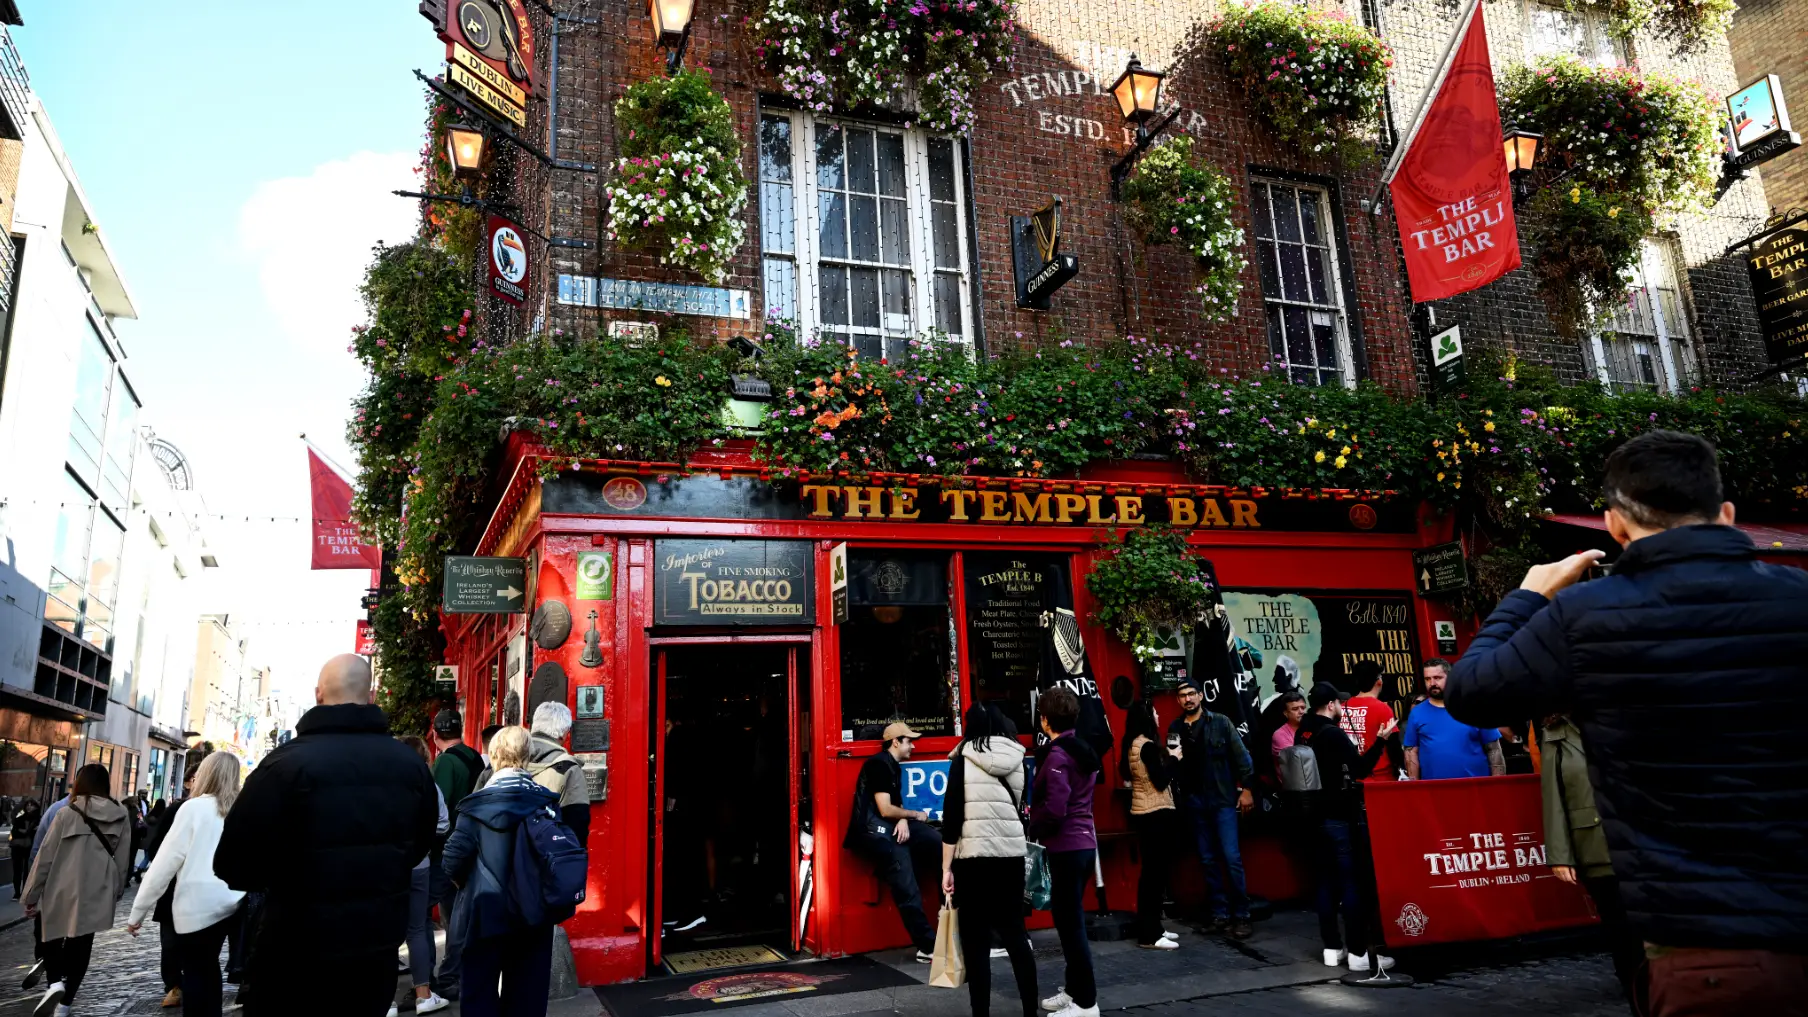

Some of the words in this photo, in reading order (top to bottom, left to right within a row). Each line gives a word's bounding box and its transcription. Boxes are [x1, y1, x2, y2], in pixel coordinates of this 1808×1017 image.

[517, 16, 530, 53] BAR
[469, 56, 512, 95] DUBLIN
[460, 71, 485, 96] LIVE
[487, 91, 520, 120] MUSIC
[1002, 71, 1111, 107] TEMPL
[1739, 137, 1788, 165] GUINNESS
[1436, 196, 1477, 221] THE
[1443, 232, 1495, 263] BAR
[1770, 234, 1795, 249] THE
[1751, 241, 1808, 271] TEMPL
[1028, 261, 1060, 294] GUINNESS
[1770, 257, 1808, 280] BAR
[495, 277, 524, 296] GUINNESS
[1762, 297, 1786, 312] BEER
[1787, 288, 1808, 302] GAR
[1771, 327, 1796, 342] LIVE
[1787, 332, 1808, 346] DAI
[608, 483, 637, 502] 48
[803, 485, 920, 520] THE
[942, 489, 1146, 525] TEMPLE
[1168, 497, 1261, 527] BAR
[318, 535, 364, 545] TEMPL
[334, 528, 356, 536] THE
[331, 546, 360, 554] BAR
[661, 547, 725, 577] Importers
[701, 561, 713, 569] OF
[718, 566, 742, 576] FINE
[744, 567, 790, 576] SMOKING
[977, 571, 1031, 587] TEMPLE
[682, 572, 791, 611] TOBACCO
[703, 604, 745, 614] Always
[752, 604, 761, 613] in
[768, 604, 801, 613] Stock
[981, 610, 998, 618] Meat
[1259, 601, 1293, 618] THE
[1382, 604, 1406, 624] 1840
[973, 620, 992, 628] Fresh
[1244, 618, 1310, 634] TEMPLE
[1263, 634, 1298, 651] BAR
[1376, 629, 1410, 651] THE
[1397, 676, 1415, 697] OF
[906, 767, 948, 797] PO
[1470, 833, 1506, 849] THE
[1424, 850, 1510, 875] TEMPLE
[1459, 877, 1489, 888] DUBLIN
[1495, 874, 1530, 885] IRELAND
